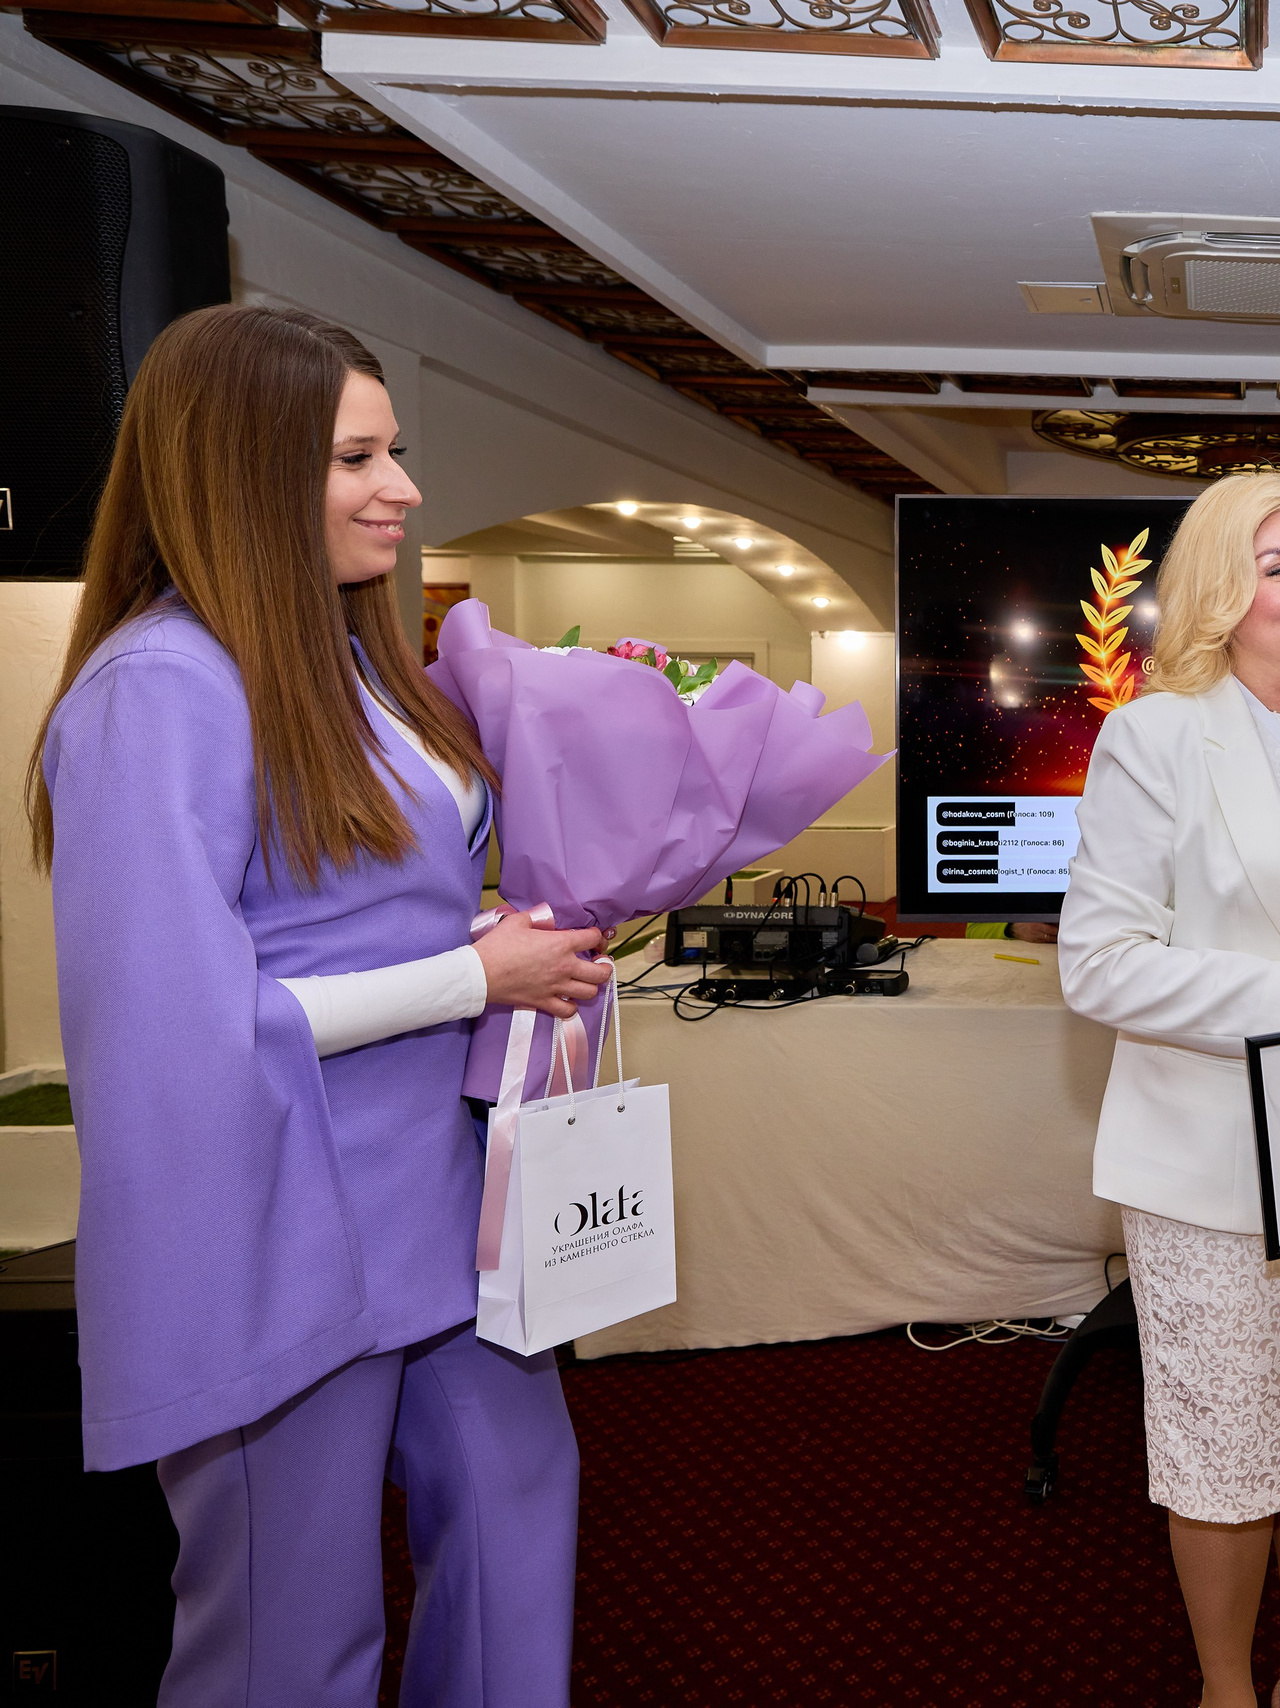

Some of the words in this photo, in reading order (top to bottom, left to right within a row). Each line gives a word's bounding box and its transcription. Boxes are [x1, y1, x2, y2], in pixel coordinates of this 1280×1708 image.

[941, 810, 1006, 819] @hodakova_cosm
[1039, 810, 1055, 819] 109)
[544, 1258, 557, 1268] ИЗ
[560, 1239, 619, 1264] КАМЕННОГО
[620, 1228, 655, 1244] СТЕКЛА
[551, 1230, 610, 1255] УКРАШЕНИЯ
[612, 1221, 644, 1236] ОЛАФА
